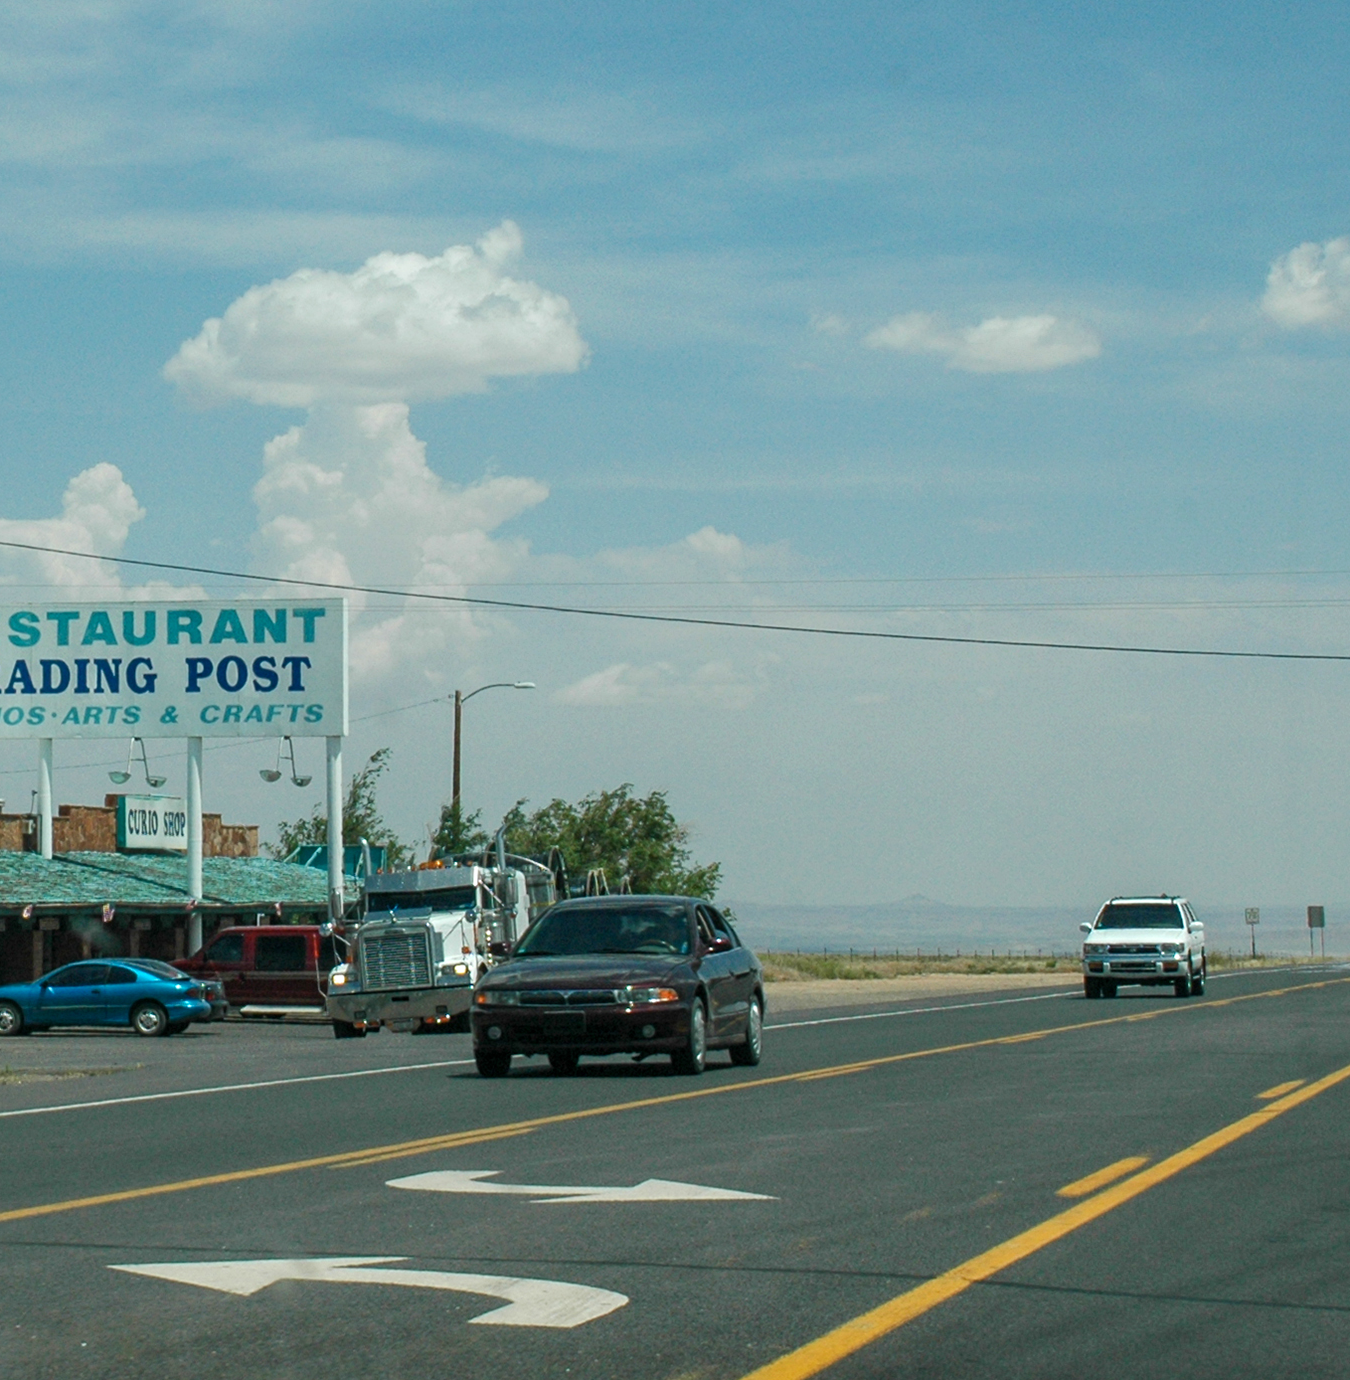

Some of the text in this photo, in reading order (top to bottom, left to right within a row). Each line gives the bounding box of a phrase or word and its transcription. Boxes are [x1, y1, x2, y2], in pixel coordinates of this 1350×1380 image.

[185, 655, 312, 693] POST
[159, 705, 179, 724] &
[199, 703, 325, 724] CRAFTS
[127, 808, 186, 837] CURIO SHOP
